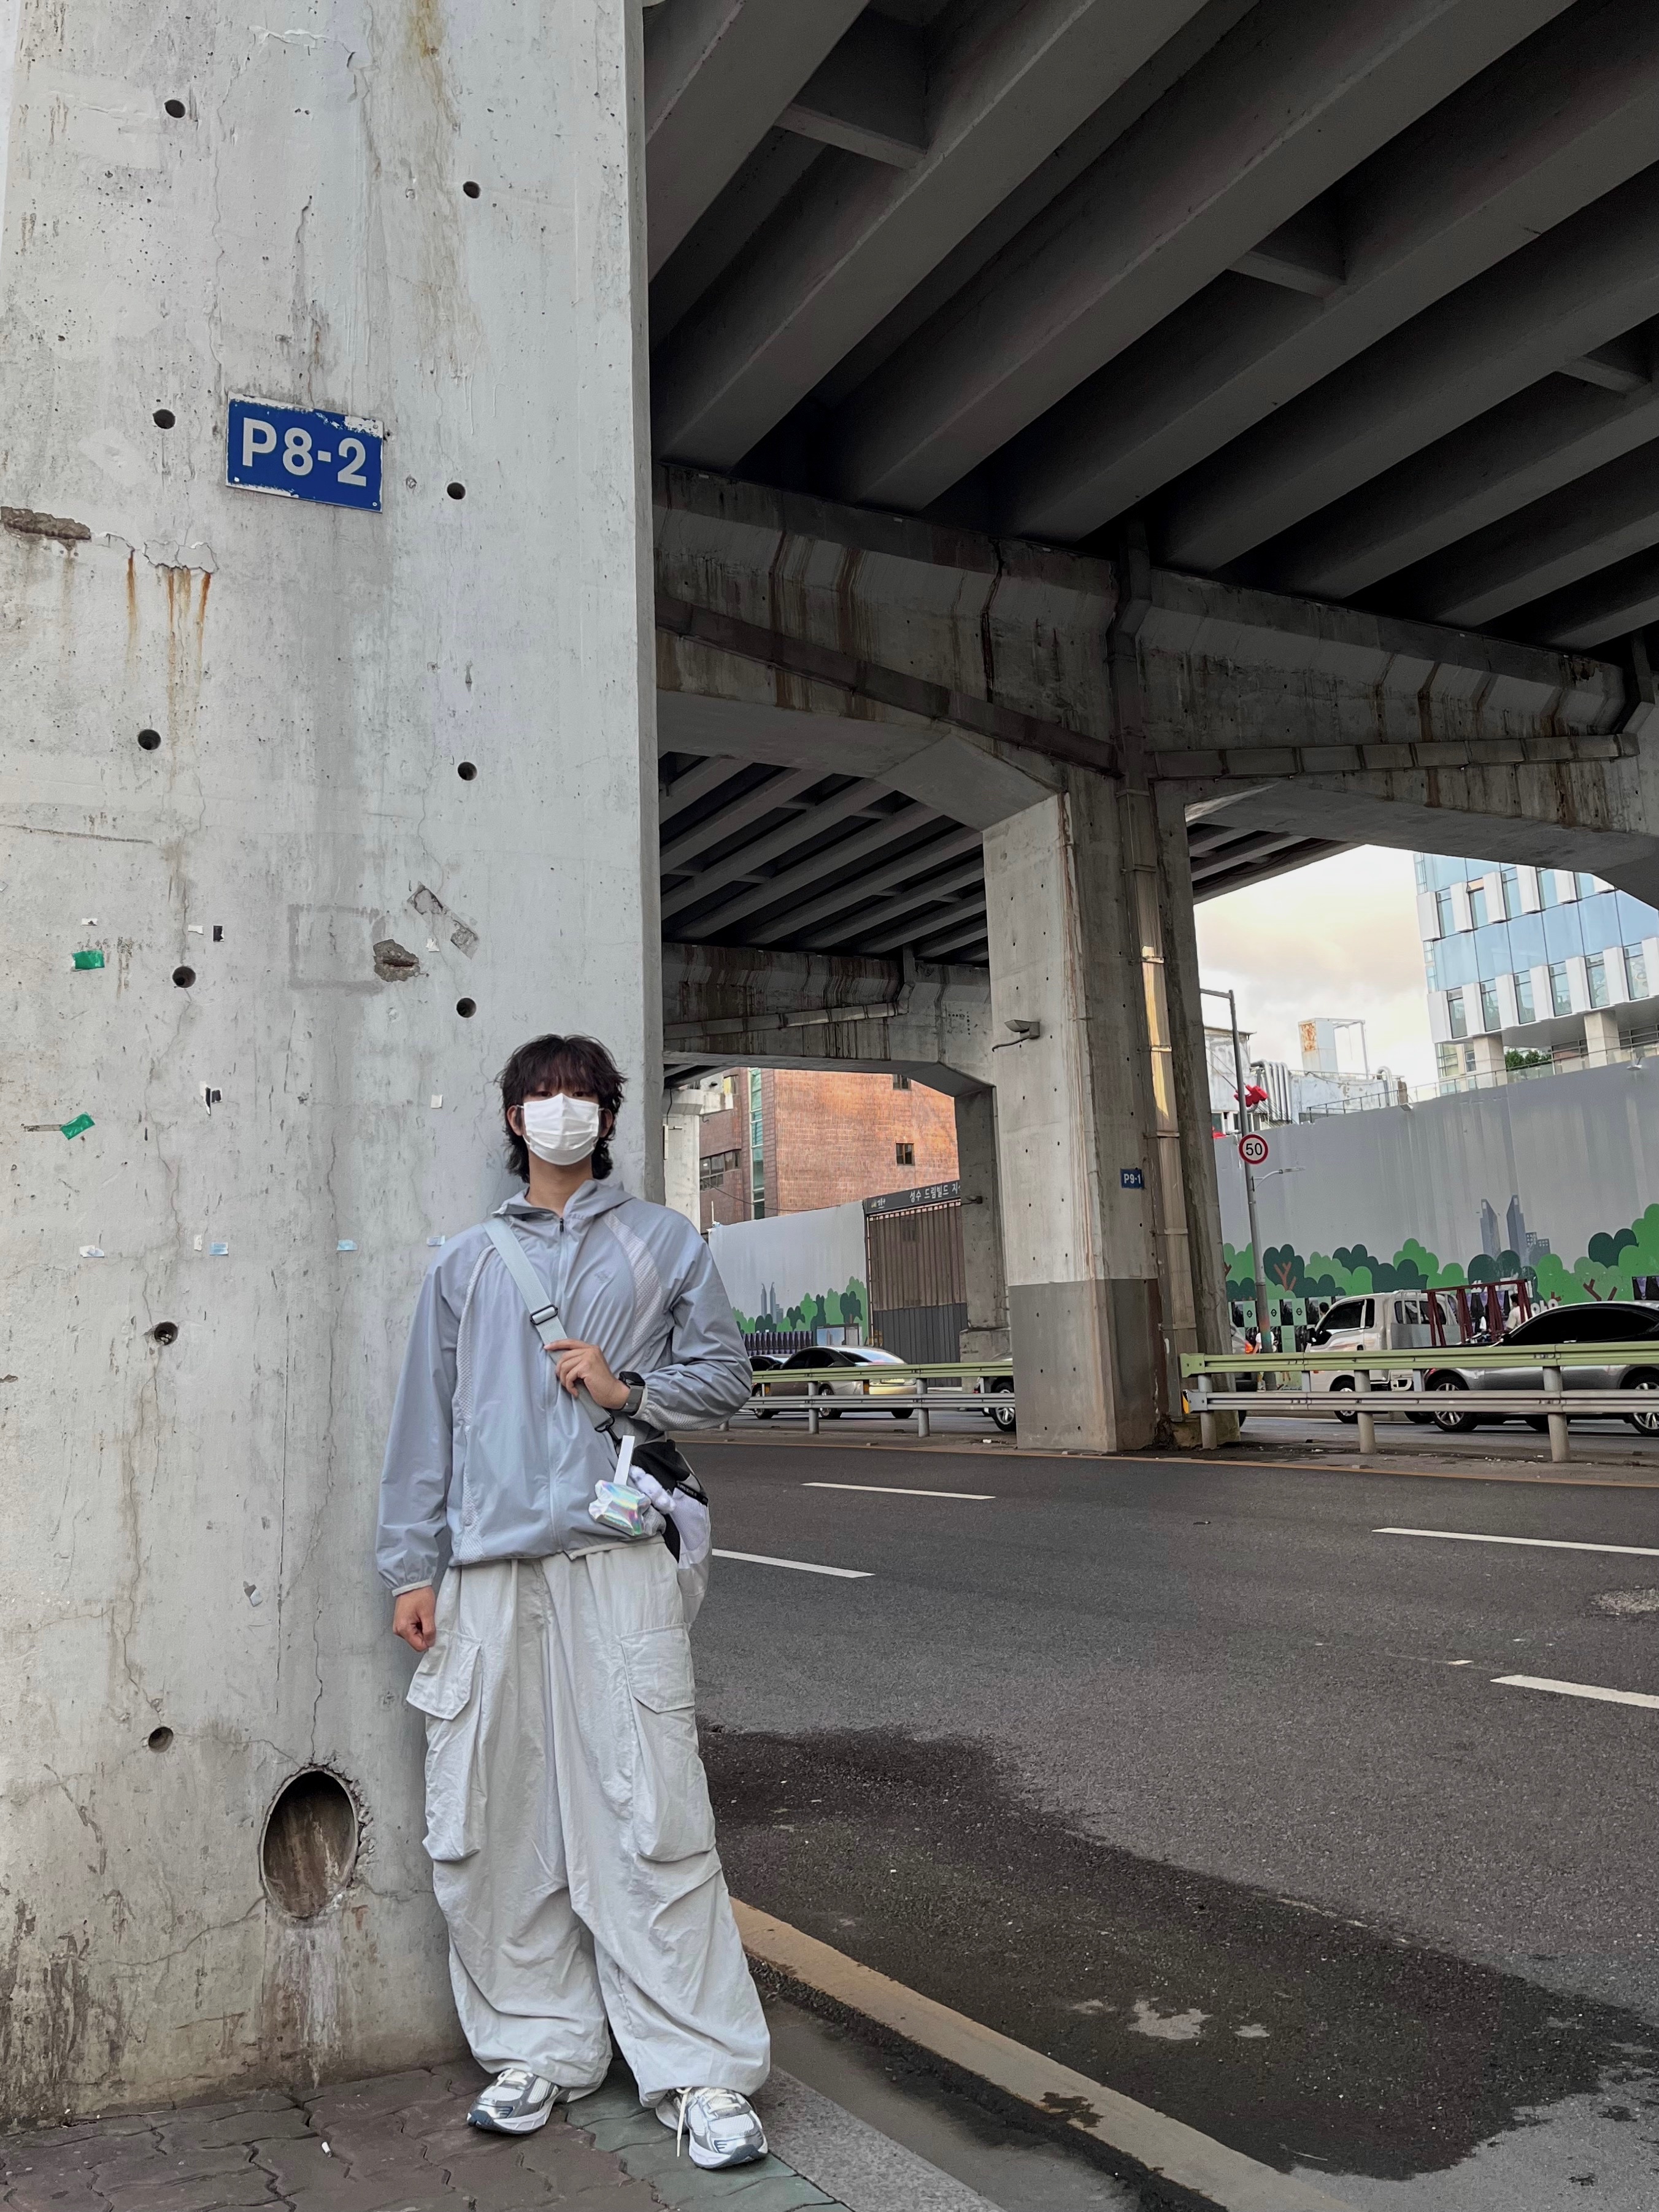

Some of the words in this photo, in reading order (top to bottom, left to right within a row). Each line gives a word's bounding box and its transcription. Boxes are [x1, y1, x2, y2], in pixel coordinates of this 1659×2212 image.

[242, 417, 366, 487] P8-2
[1245, 1143, 1263, 1156] 50
[1123, 1173, 1141, 1184] P9-1
[909, 1190, 922, 1203] 성수
[924, 1184, 949, 1199] 드림빌드
[952, 1182, 961, 1195] 지
